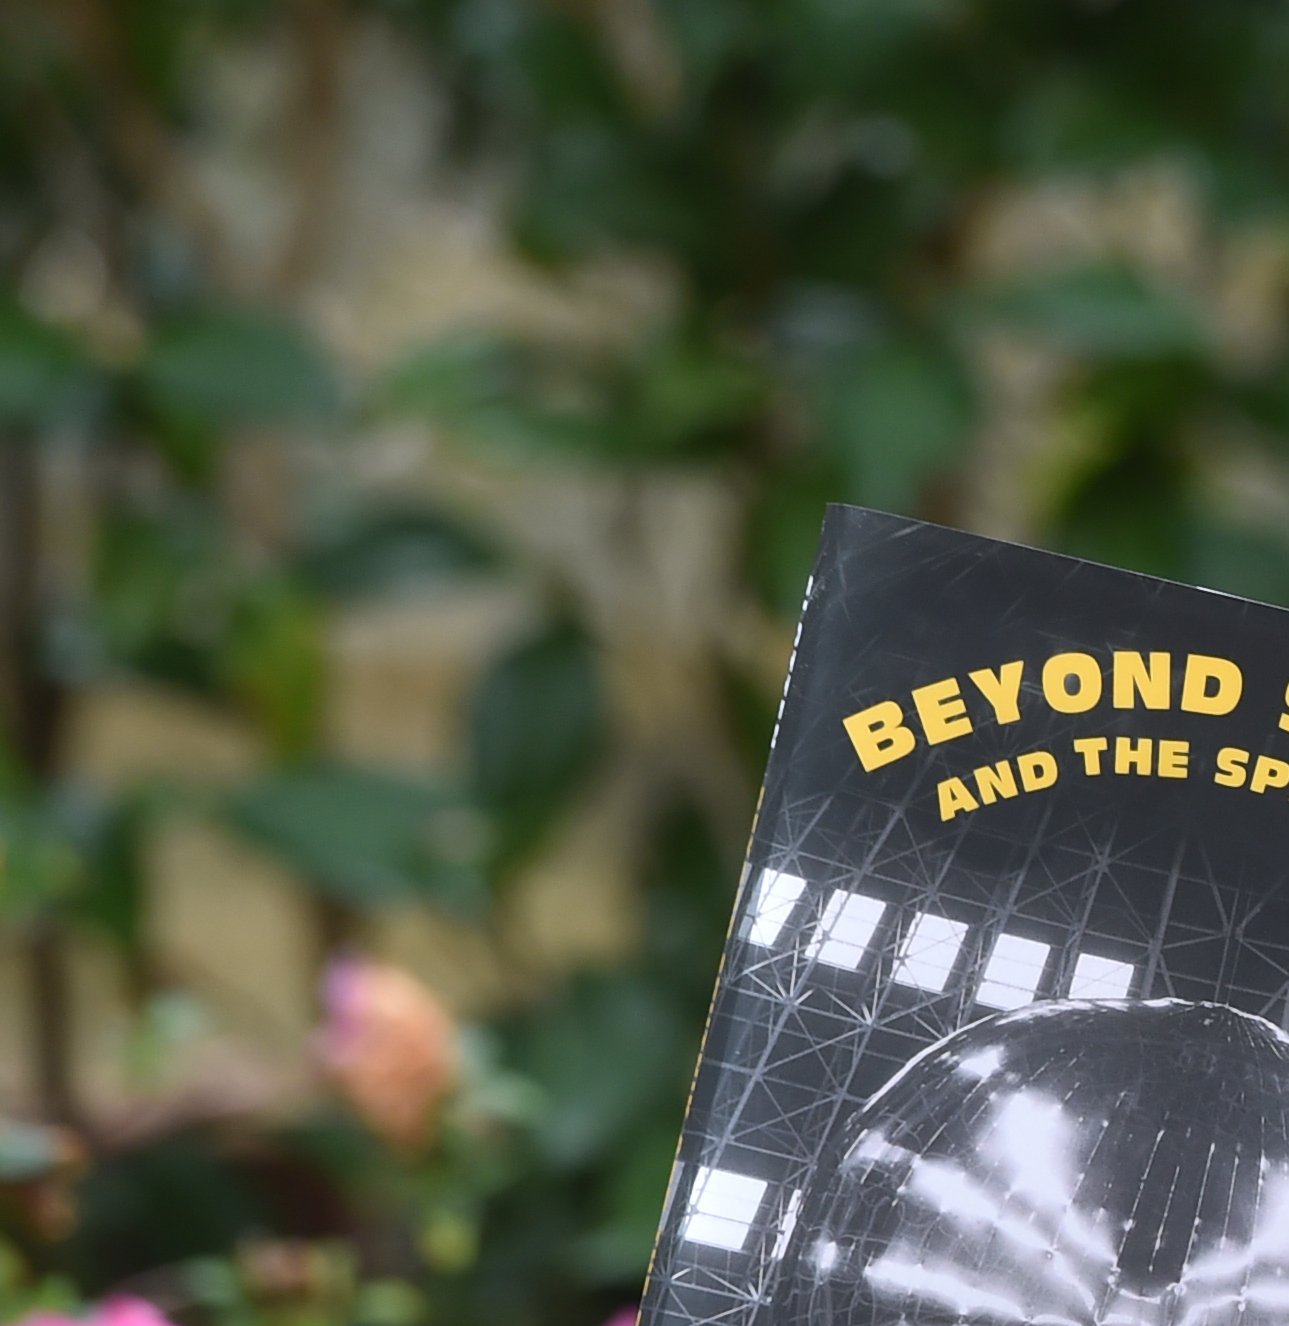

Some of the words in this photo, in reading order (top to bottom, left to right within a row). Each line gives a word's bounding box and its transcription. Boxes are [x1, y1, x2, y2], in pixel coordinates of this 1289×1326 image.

[841, 651, 1243, 773] BEYOND
[937, 750, 1060, 822] AND
[1074, 736, 1191, 780] THE
